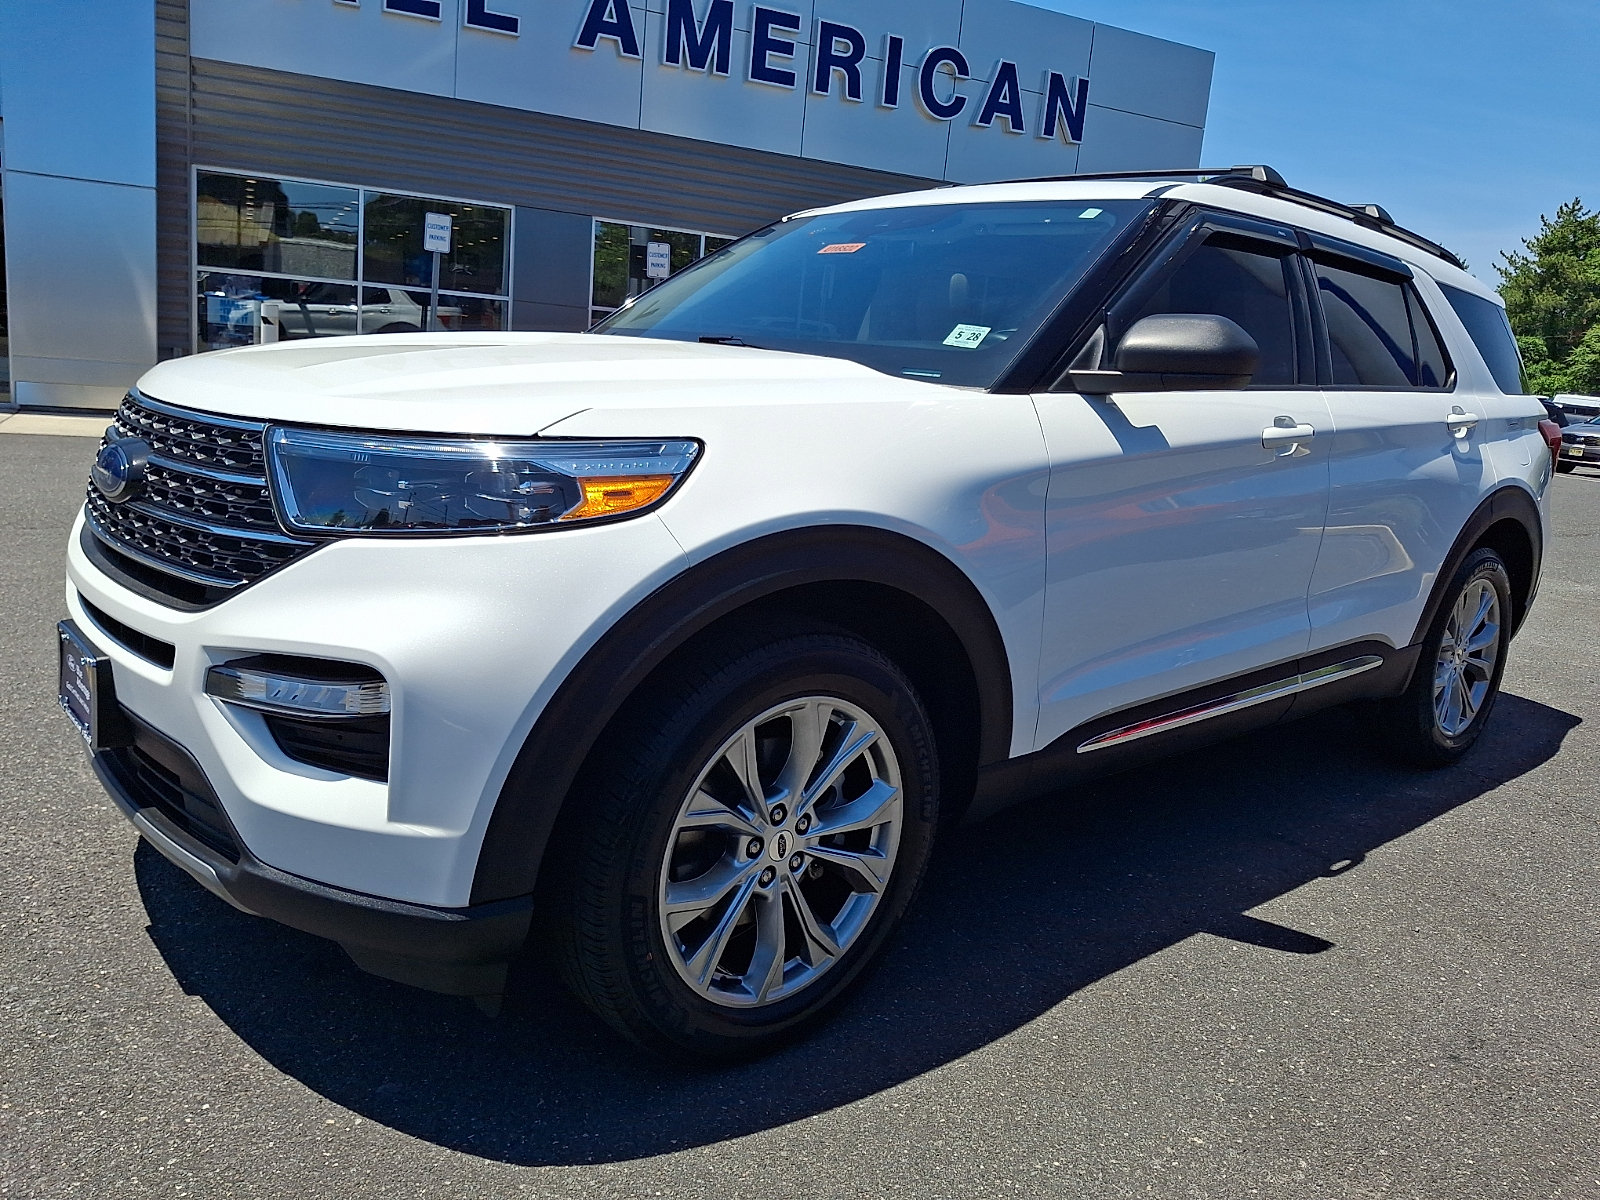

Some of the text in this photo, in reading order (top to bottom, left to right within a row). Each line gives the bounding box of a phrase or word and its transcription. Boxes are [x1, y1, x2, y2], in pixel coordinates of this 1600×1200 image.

[572, 0, 1090, 145] AMERICAN
[954, 331, 981, 341] 5 28
